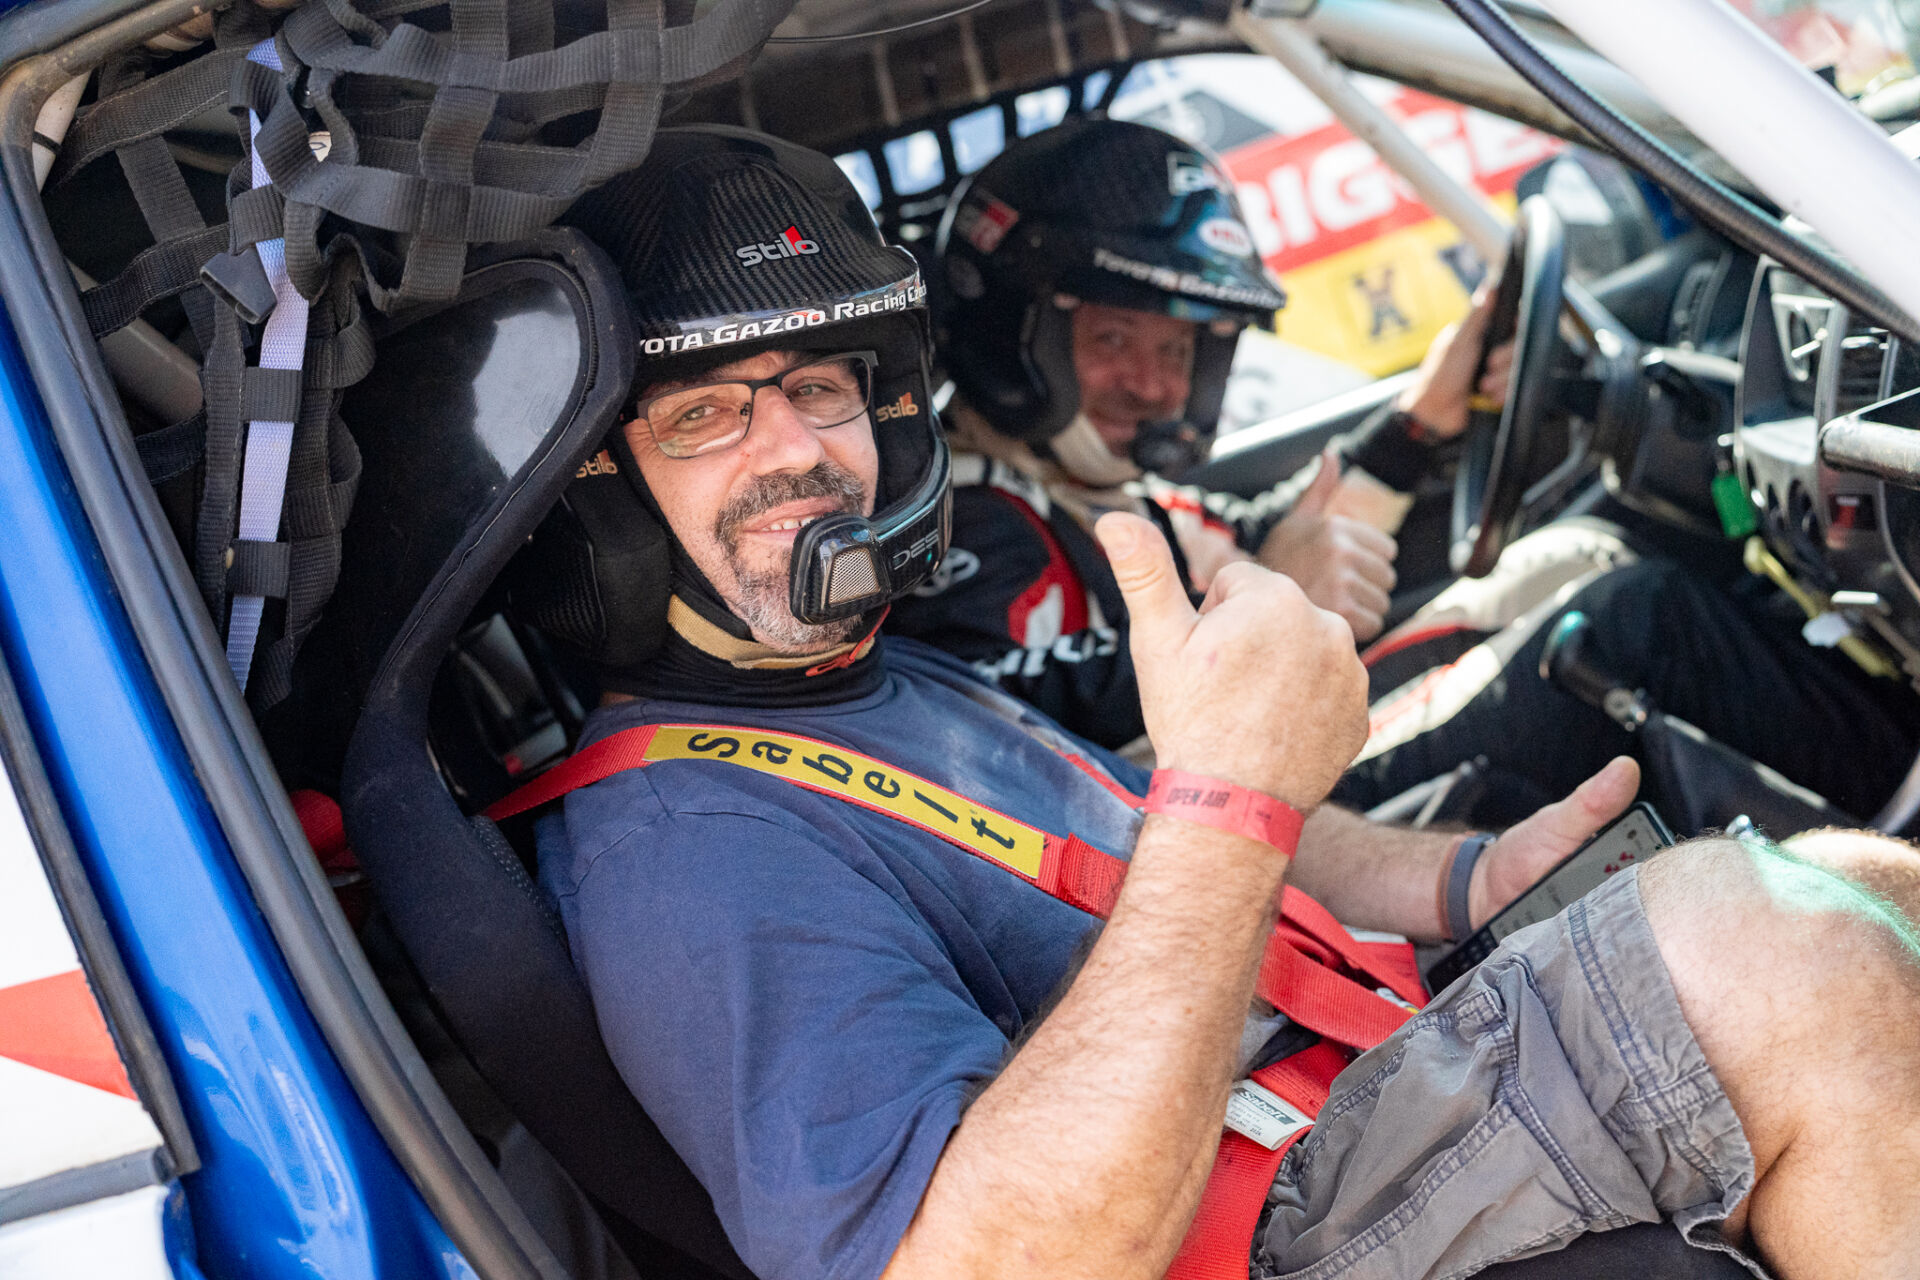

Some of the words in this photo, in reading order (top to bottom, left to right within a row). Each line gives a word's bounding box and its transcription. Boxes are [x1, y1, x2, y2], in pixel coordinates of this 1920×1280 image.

[712, 313, 826, 345] GAZOO
[833, 288, 907, 321] Racing
[687, 732, 1016, 850] Sabelt
[1165, 787, 1204, 806] OPEN
[1200, 790, 1230, 809] AIR
